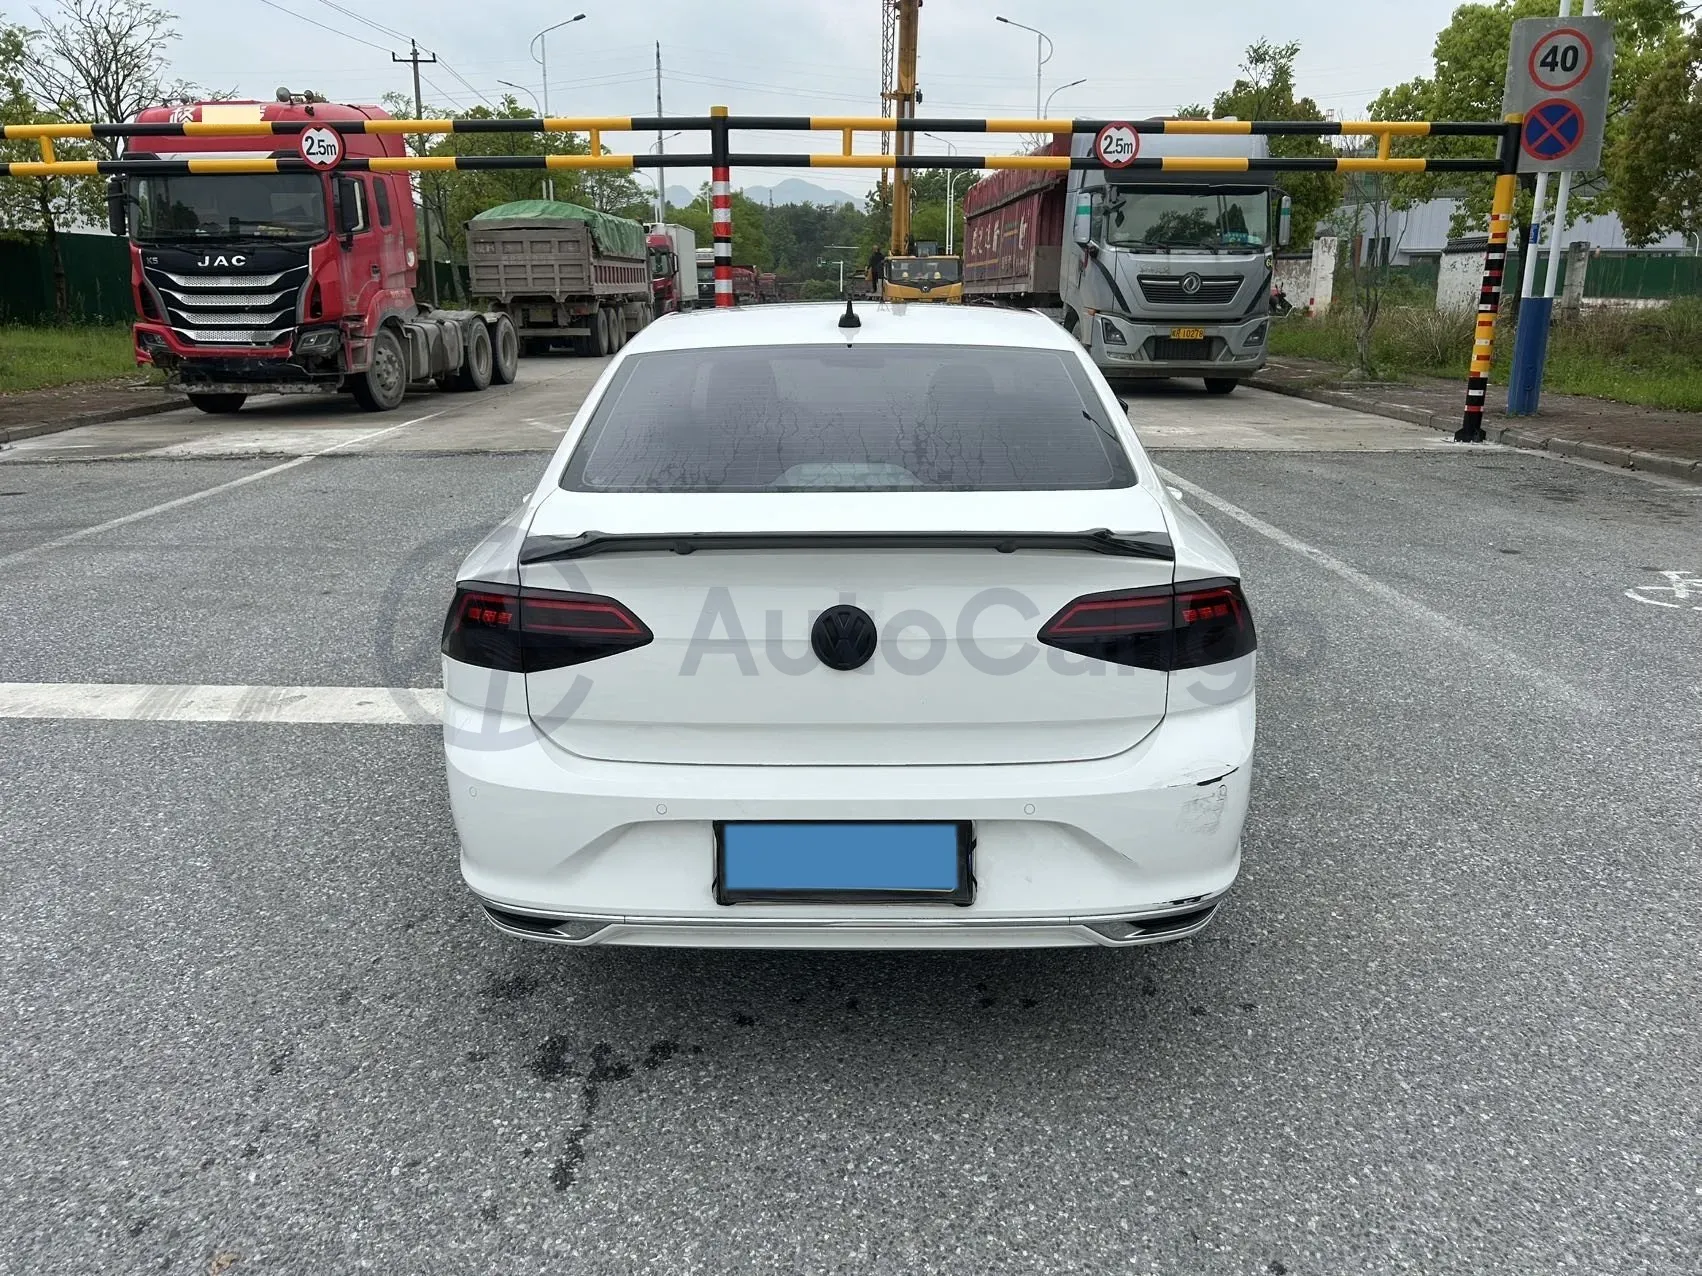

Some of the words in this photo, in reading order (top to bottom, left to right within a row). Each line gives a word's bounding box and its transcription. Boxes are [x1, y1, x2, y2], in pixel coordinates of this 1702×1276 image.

[1540, 45, 1579, 72] 40
[304, 135, 337, 156] 2.5m
[1103, 134, 1133, 155] 2.5m
[197, 255, 246, 267] JAC
